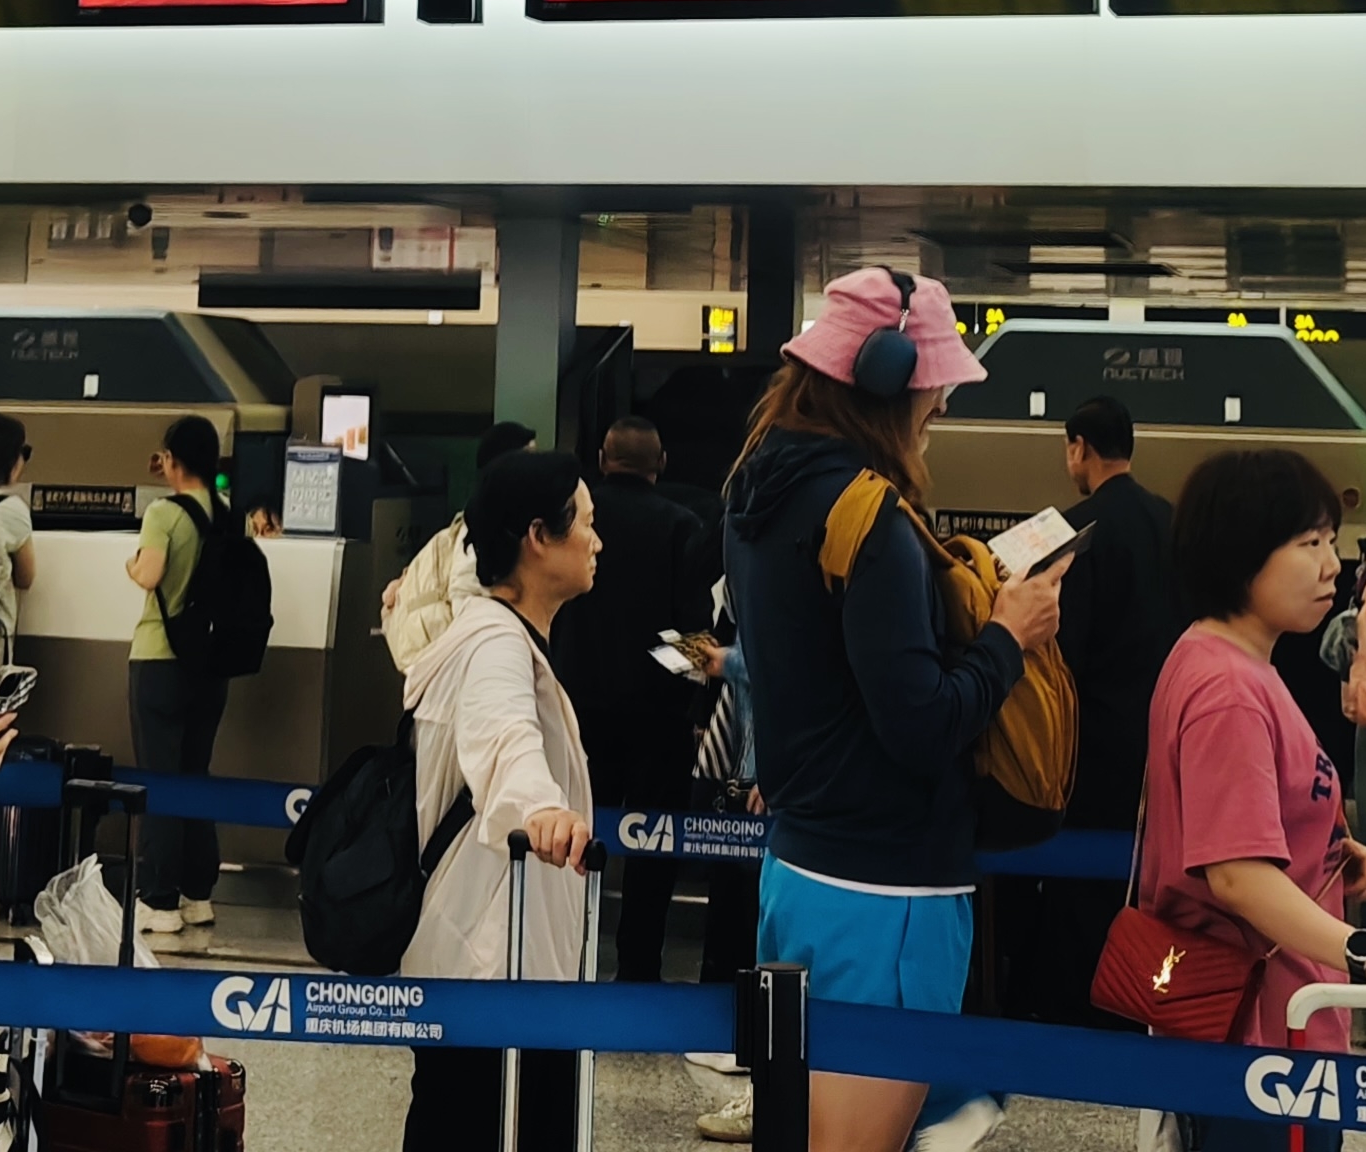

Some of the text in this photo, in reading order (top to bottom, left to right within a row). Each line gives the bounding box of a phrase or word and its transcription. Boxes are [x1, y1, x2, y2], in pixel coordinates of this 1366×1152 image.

[286, 788, 313, 825] G
[684, 817, 764, 837] CHONGQING
[306, 982, 423, 1007] CHONGQING
[305, 1017, 443, 1040] 重庆机场集团有限公司
